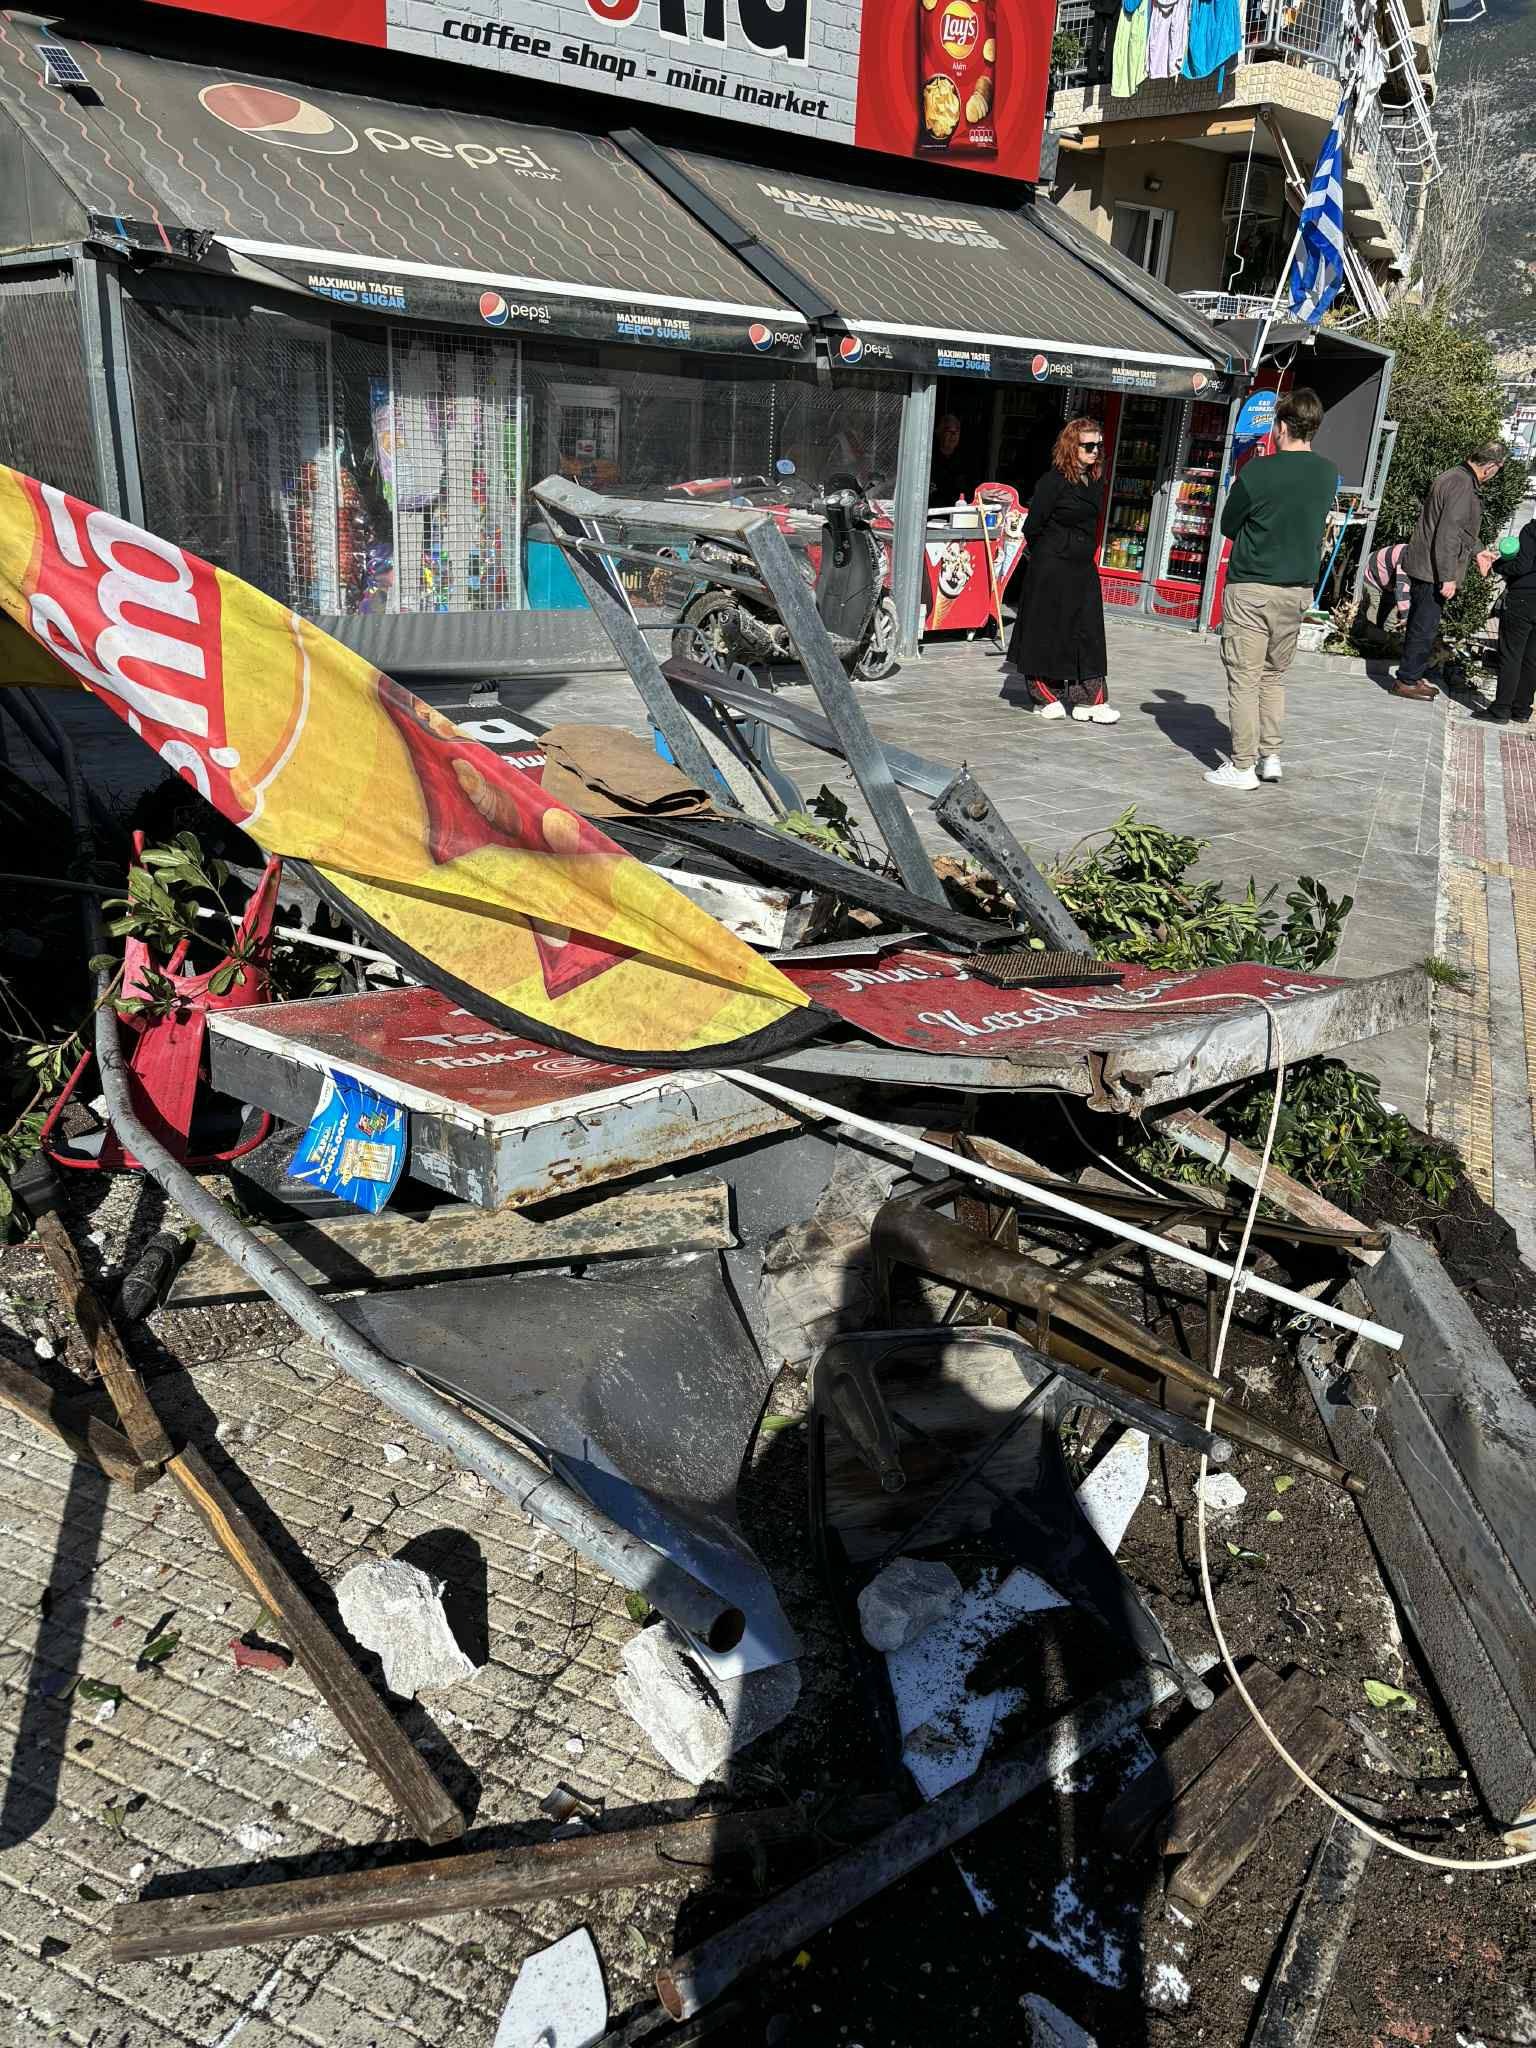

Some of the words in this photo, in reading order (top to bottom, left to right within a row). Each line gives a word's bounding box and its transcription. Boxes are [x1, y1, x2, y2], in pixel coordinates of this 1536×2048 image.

[942, 13, 976, 46] Lay's
[442, 18, 551, 60] coffee
[561, 37, 637, 82] shop
[645, 67, 657, 77] -
[666, 67, 727, 98] mini
[735, 84, 829, 120] market
[364, 127, 556, 173] pepsi
[514, 168, 562, 182] max
[756, 183, 905, 223] MAXIMUM
[901, 211, 989, 235] TASTE
[773, 198, 896, 235] ZERO
[899, 223, 1009, 251] SUGAR
[308, 275, 367, 292] MAXIMUM
[368, 282, 405, 297] TASTE
[361, 292, 406, 310] SUGAR
[511, 302, 550, 321] pepsi
[616, 312, 662, 326] MAXIMUM
[663, 318, 690, 330] TASTE
[617, 322, 655, 337] ZERO
[656, 327, 691, 341] SUGAR
[774, 331, 803, 347] pepsi
[937, 348, 969, 360] MAXIMUM
[969, 353, 991, 363] TASTE
[937, 358, 965, 370] ZERO
[965, 361, 992, 373] SUGAR
[1049, 362, 1073, 377] pepsi
[1112, 367, 1142, 378] MAXIMUM
[1142, 371, 1157, 380] TASTE
[1111, 375, 1135, 386] ZERO
[1134, 377, 1157, 389] SUGAR
[414, 1049, 551, 1070] Take
